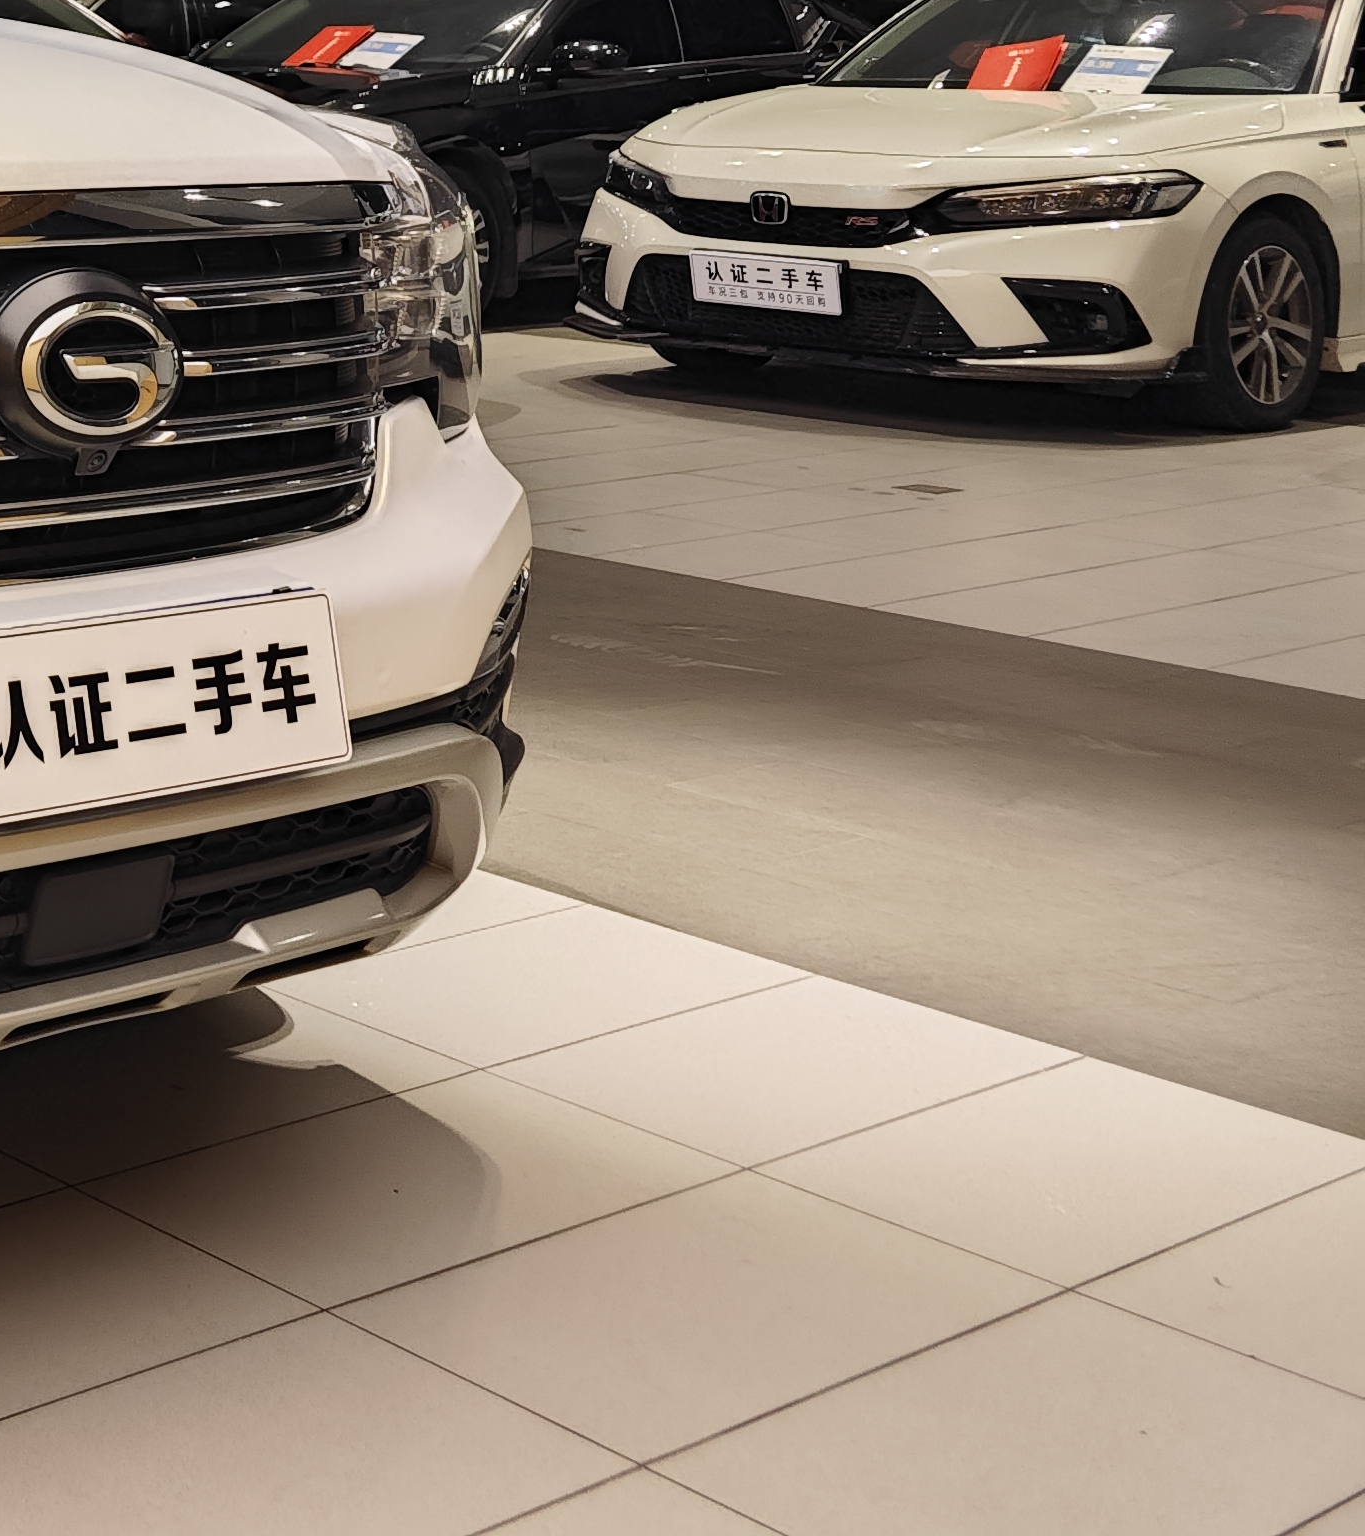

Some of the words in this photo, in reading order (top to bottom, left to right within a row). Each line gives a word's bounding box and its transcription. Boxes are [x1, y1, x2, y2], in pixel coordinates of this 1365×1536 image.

[705, 261, 824, 291] 认证二手车
